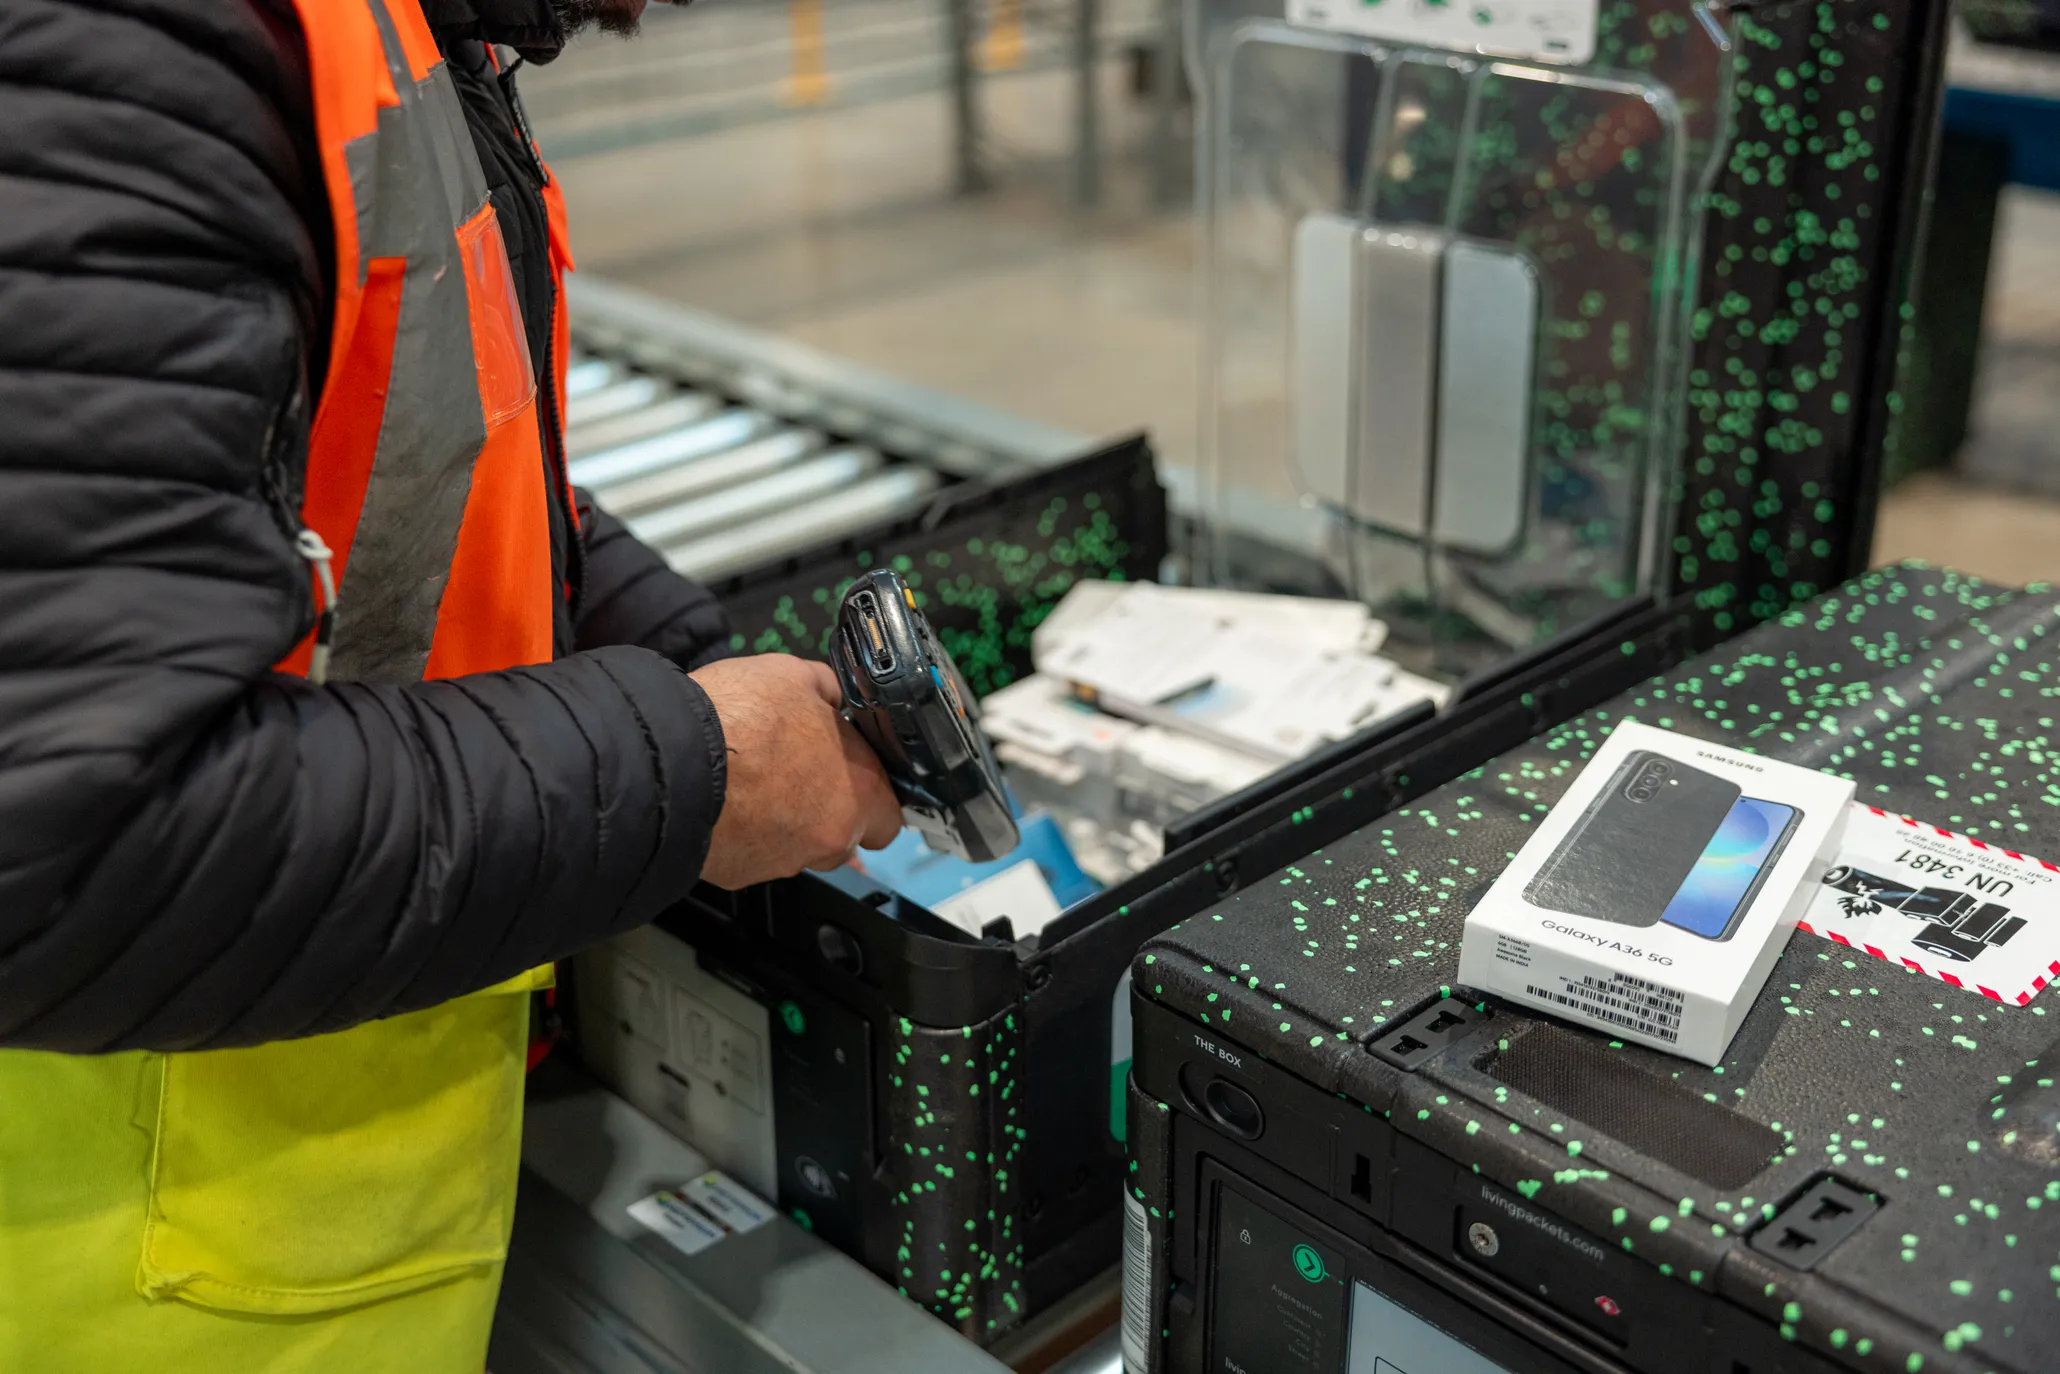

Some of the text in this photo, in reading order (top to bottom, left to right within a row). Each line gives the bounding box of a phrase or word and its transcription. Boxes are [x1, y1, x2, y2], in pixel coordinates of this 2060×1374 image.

[1697, 751, 1764, 772] SAMSUNG
[1895, 849, 2014, 897] UN 3481
[1977, 862, 2012, 876] more
[2014, 874, 2036, 885] For
[1541, 919, 1674, 966] Galaxy A36 5G
[1515, 959, 1529, 967] INDIA
[1194, 1034, 1241, 1068] THE BOX
[1481, 1185, 1605, 1261] livingpackets.com
[1271, 1283, 1323, 1320] Aggregation
